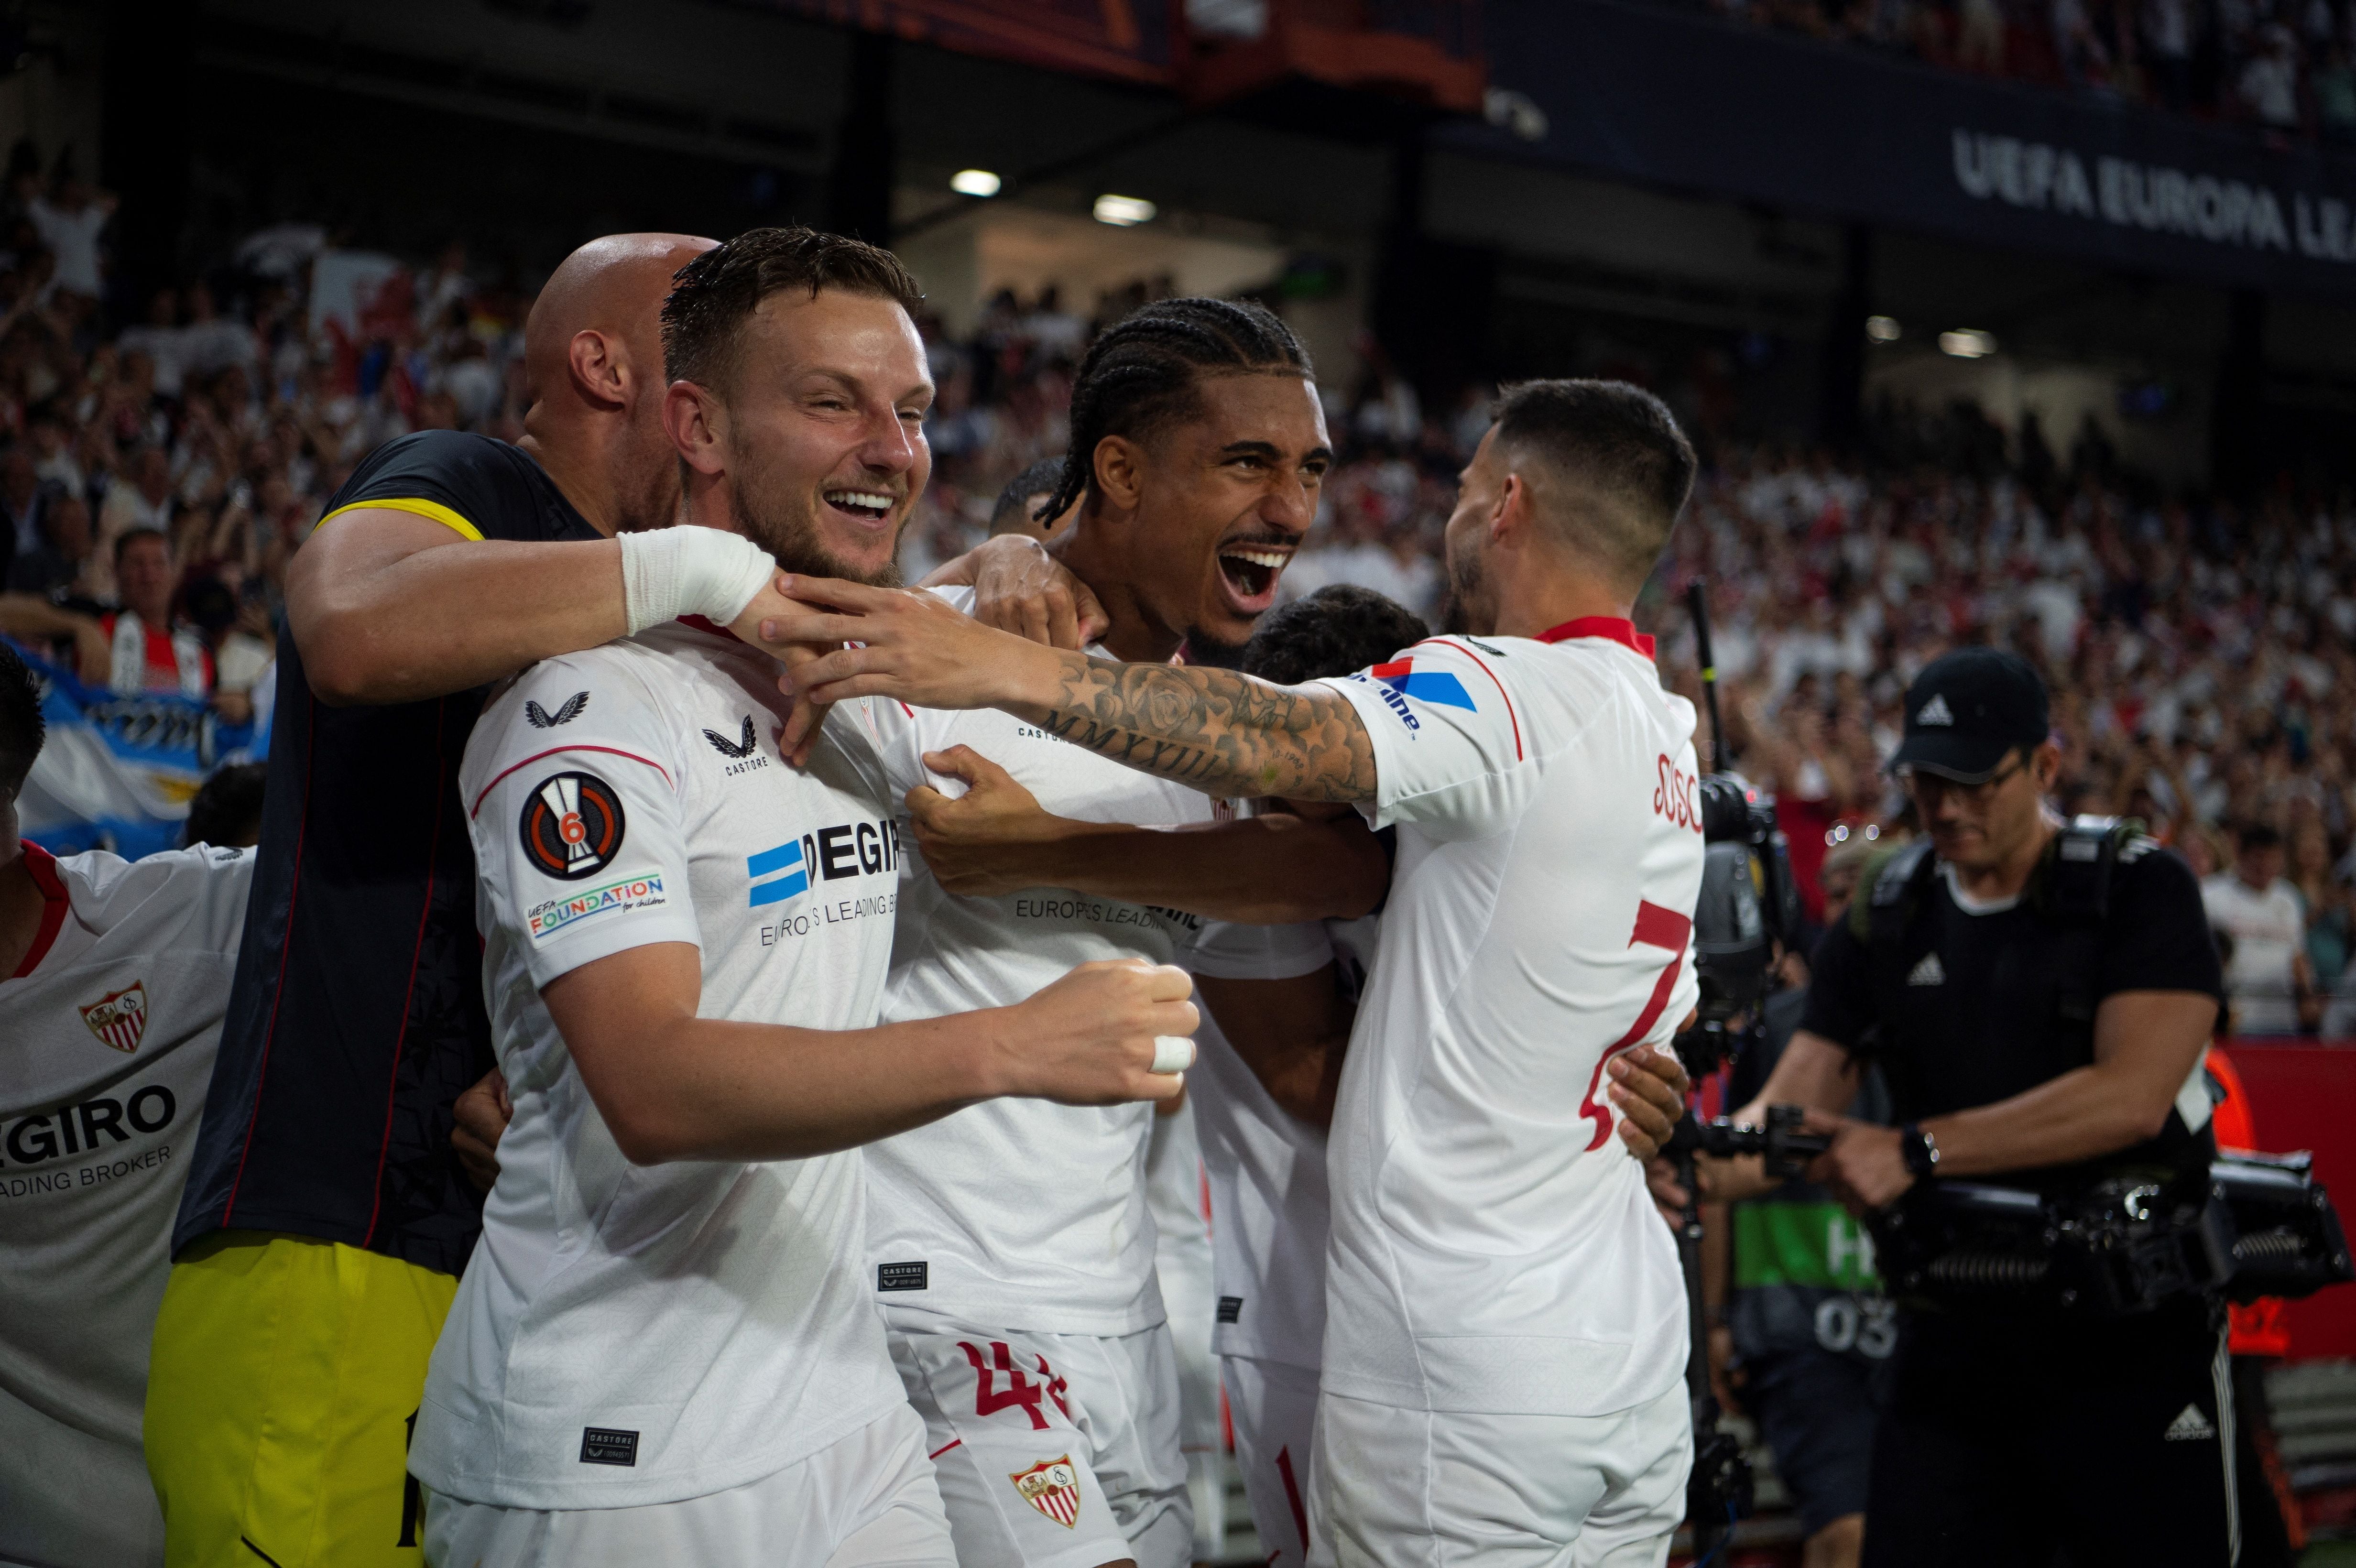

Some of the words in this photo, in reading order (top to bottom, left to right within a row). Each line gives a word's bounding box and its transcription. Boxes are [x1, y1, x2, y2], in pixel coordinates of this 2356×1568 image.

[1951, 126, 2095, 219] UEFA
[2096, 154, 2293, 254] EUROPA
[2295, 193, 2356, 264] LE
[725, 756, 768, 776] CASTORE
[560, 812, 586, 844] 6
[528, 900, 556, 918] UEFA
[530, 879, 664, 934] FOUNDATION
[623, 901, 633, 913] for
[636, 898, 665, 908] children
[825, 895, 886, 923] LEADING
[1579, 899, 1691, 1152] 7
[0, 1085, 176, 1167] GIRO
[80, 1146, 171, 1186] BROKER
[883, 1267, 922, 1275] CASTORE
[590, 1434, 632, 1444] CASTORE
